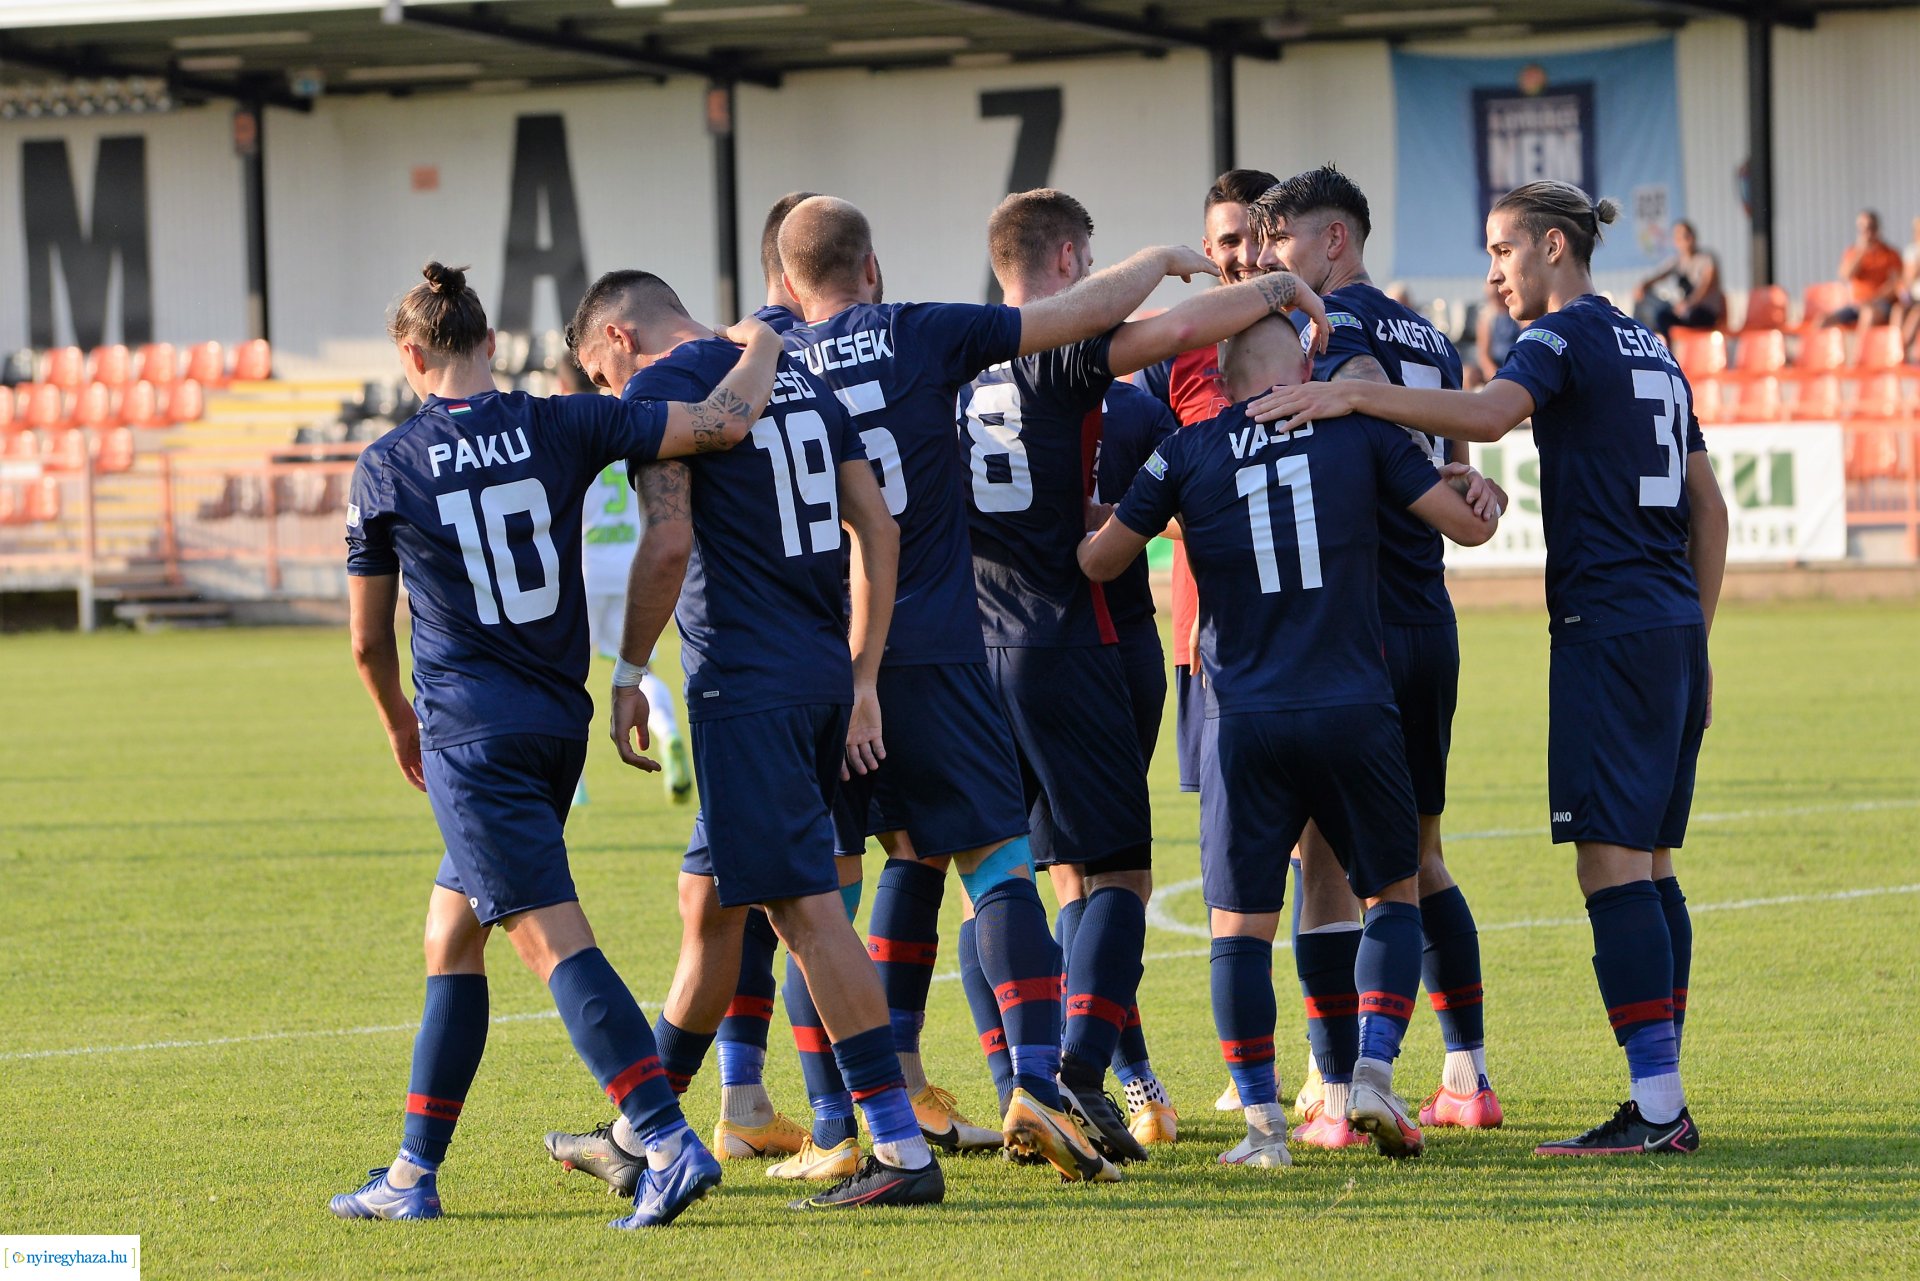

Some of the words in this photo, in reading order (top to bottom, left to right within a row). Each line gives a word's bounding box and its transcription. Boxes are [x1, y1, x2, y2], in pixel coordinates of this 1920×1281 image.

[427, 427, 532, 477] PAKU
[751, 409, 841, 558] 19
[965, 382, 1034, 513] 8
[436, 477, 560, 625] 10
[1235, 453, 1323, 594] 11
[1552, 811, 1572, 823] JAKO
